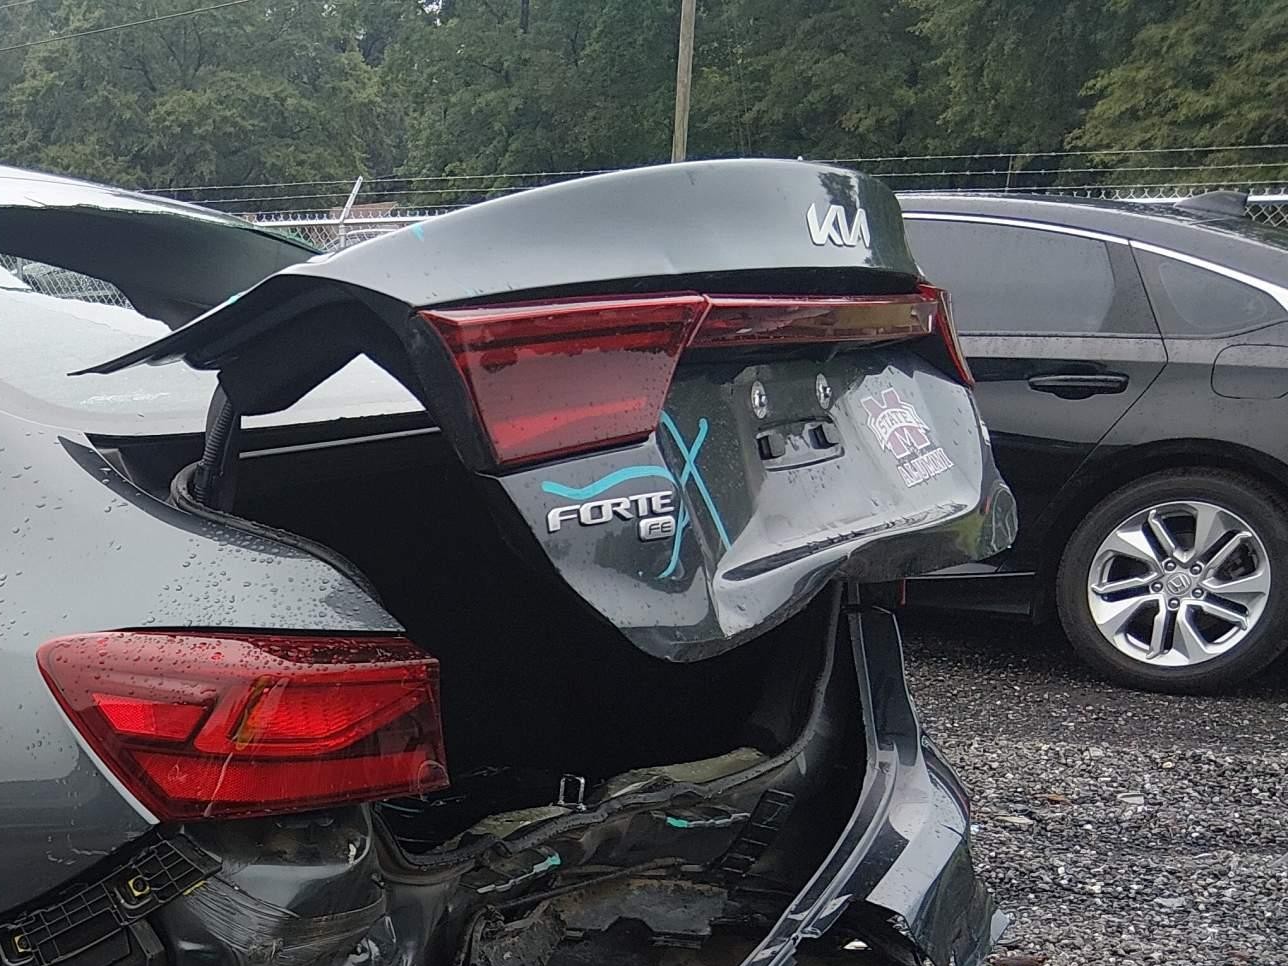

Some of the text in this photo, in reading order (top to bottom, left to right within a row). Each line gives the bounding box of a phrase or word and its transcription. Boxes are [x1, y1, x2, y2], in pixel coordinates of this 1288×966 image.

[806, 203, 870, 247] KIA
[876, 409, 921, 434] STATE
[897, 447, 954, 488] ALUMNI
[547, 490, 675, 532] FORTE
[648, 521, 673, 535] FE
